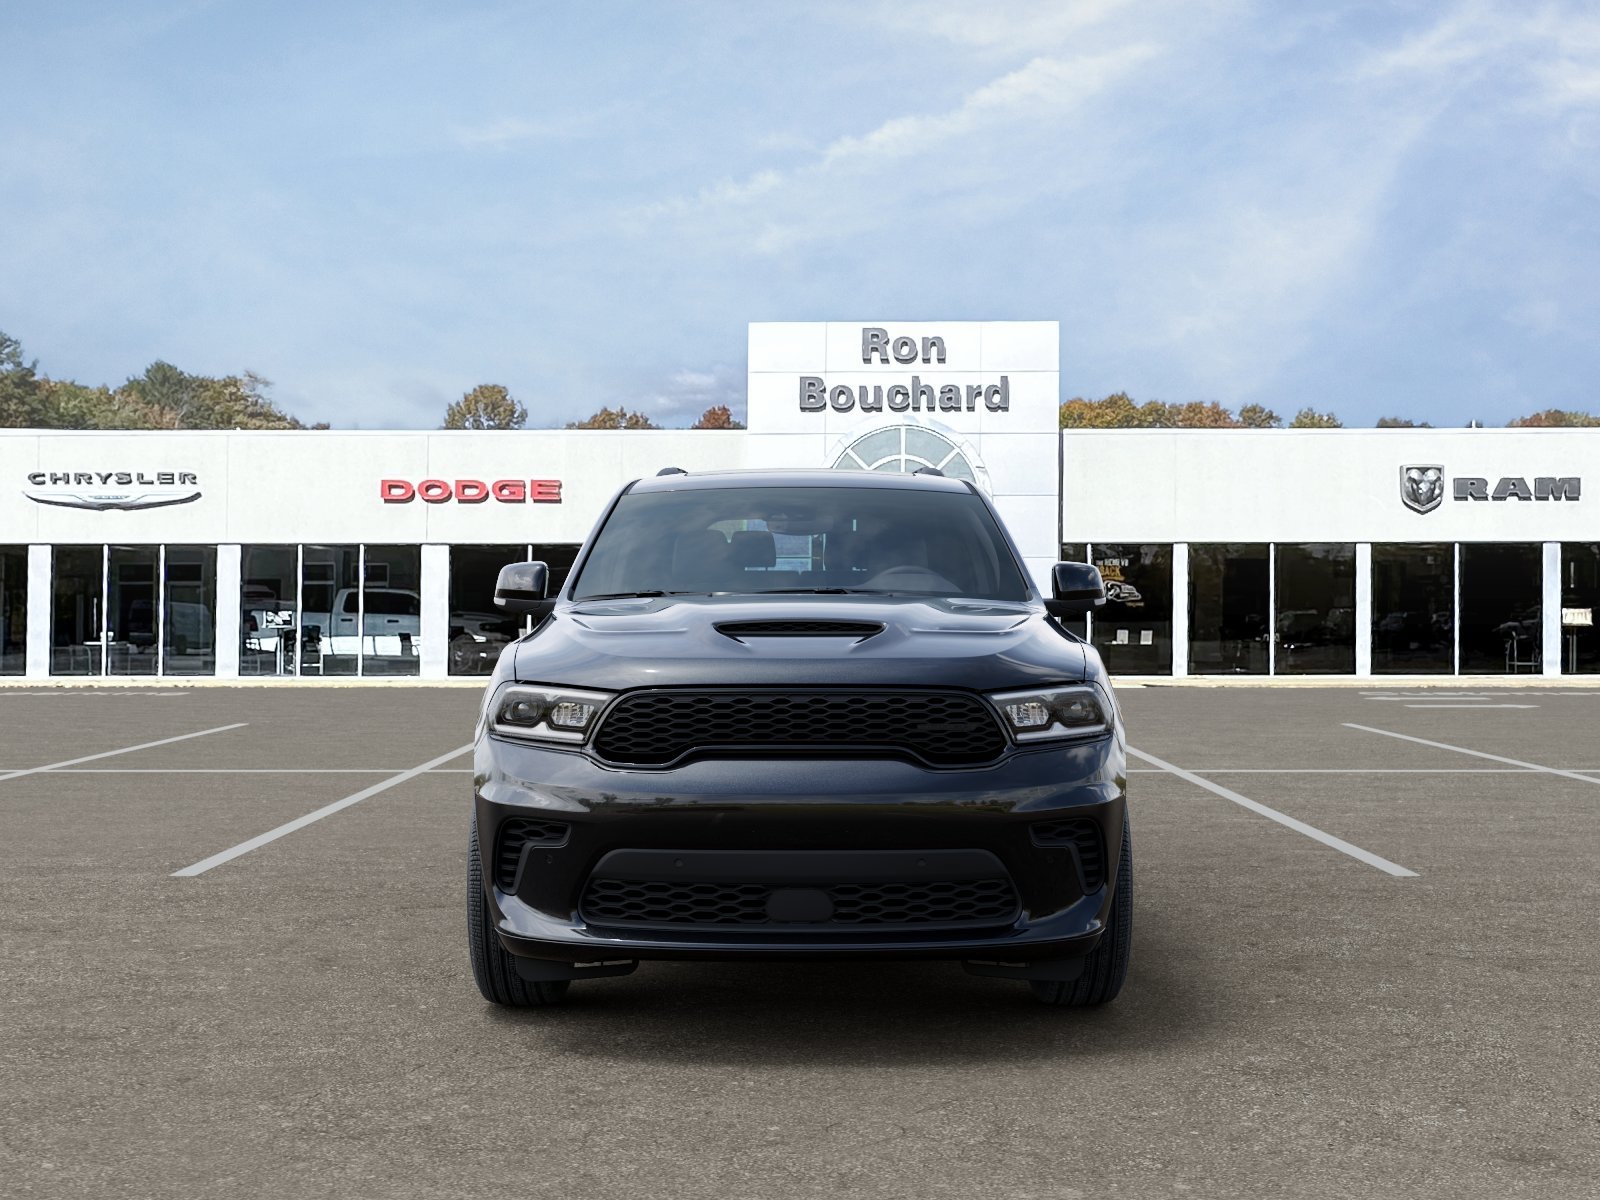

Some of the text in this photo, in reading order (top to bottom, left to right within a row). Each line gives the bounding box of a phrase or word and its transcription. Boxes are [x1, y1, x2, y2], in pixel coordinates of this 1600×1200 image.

[862, 327, 946, 364] Ron
[799, 376, 1010, 413] Bouchard
[27, 472, 198, 485] CHRYSLER
[1453, 477, 1581, 501] RAM
[380, 479, 562, 504] DODGE
